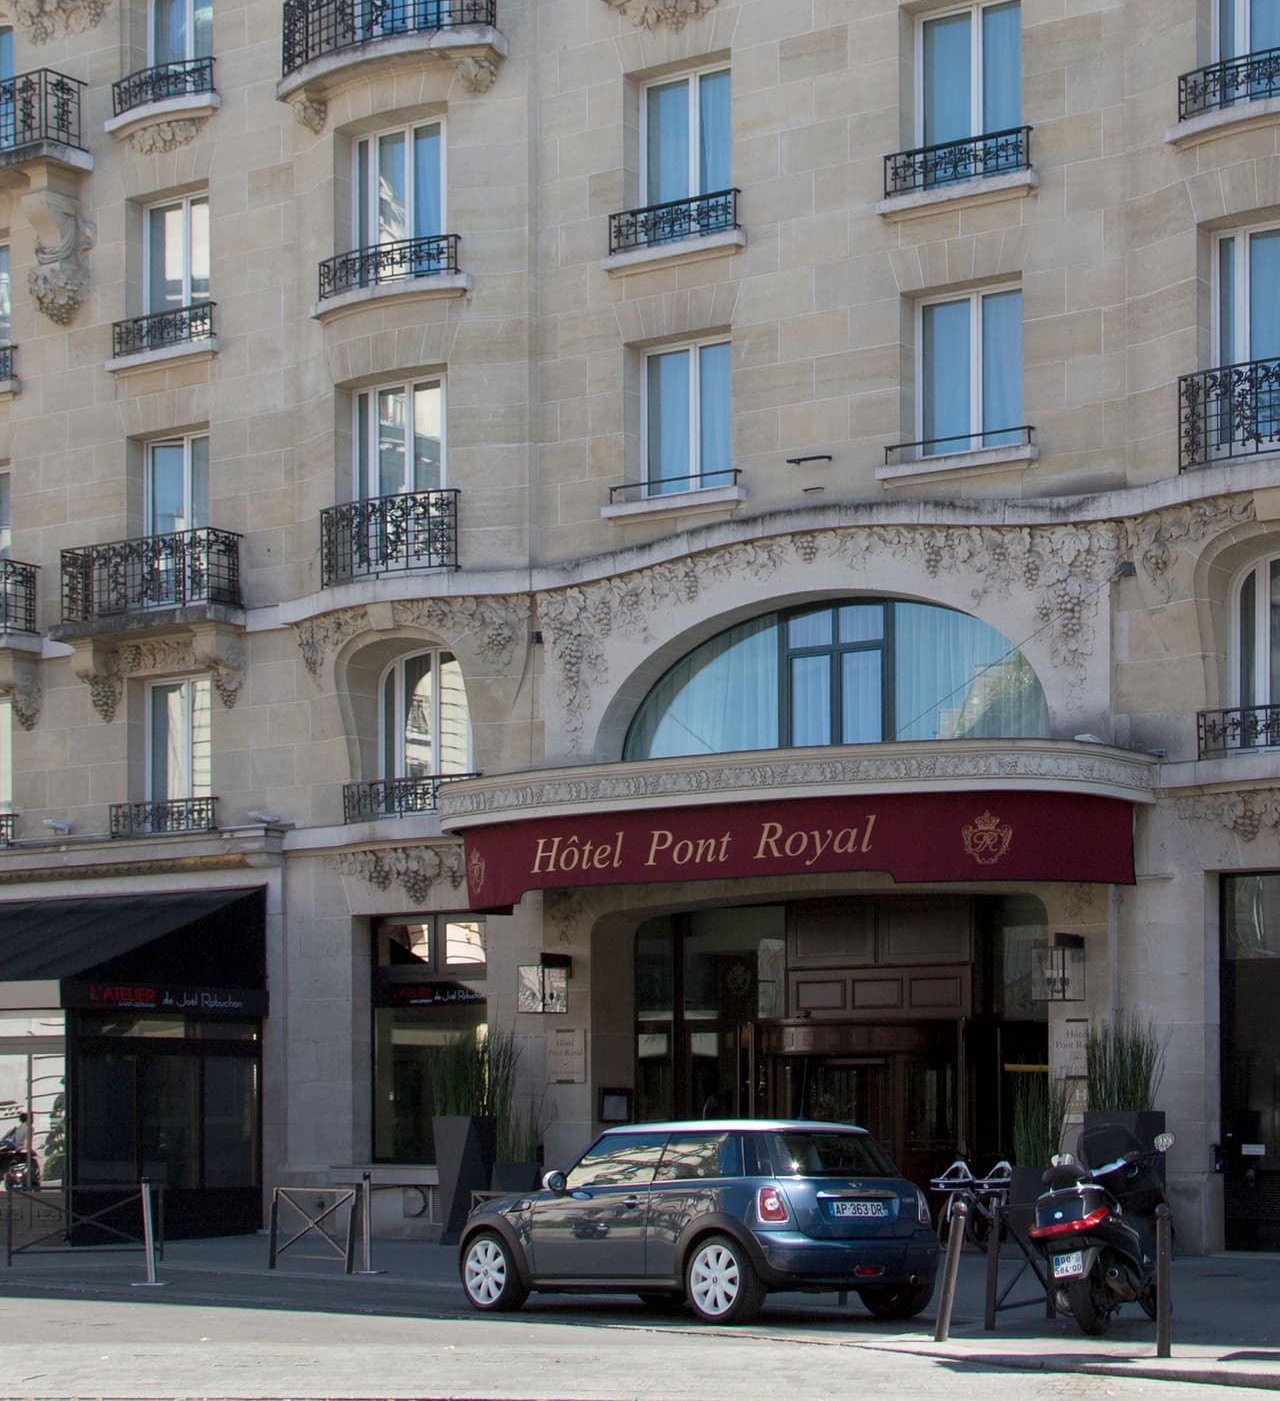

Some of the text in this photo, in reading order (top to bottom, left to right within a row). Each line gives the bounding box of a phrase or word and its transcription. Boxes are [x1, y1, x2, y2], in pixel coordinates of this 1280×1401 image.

[530, 814, 876, 873] Hôtel Pont Royal
[90, 986, 156, 1002] L'ATELIER
[162, 991, 174, 1005] de
[201, 992, 243, 1008] Robuchon
